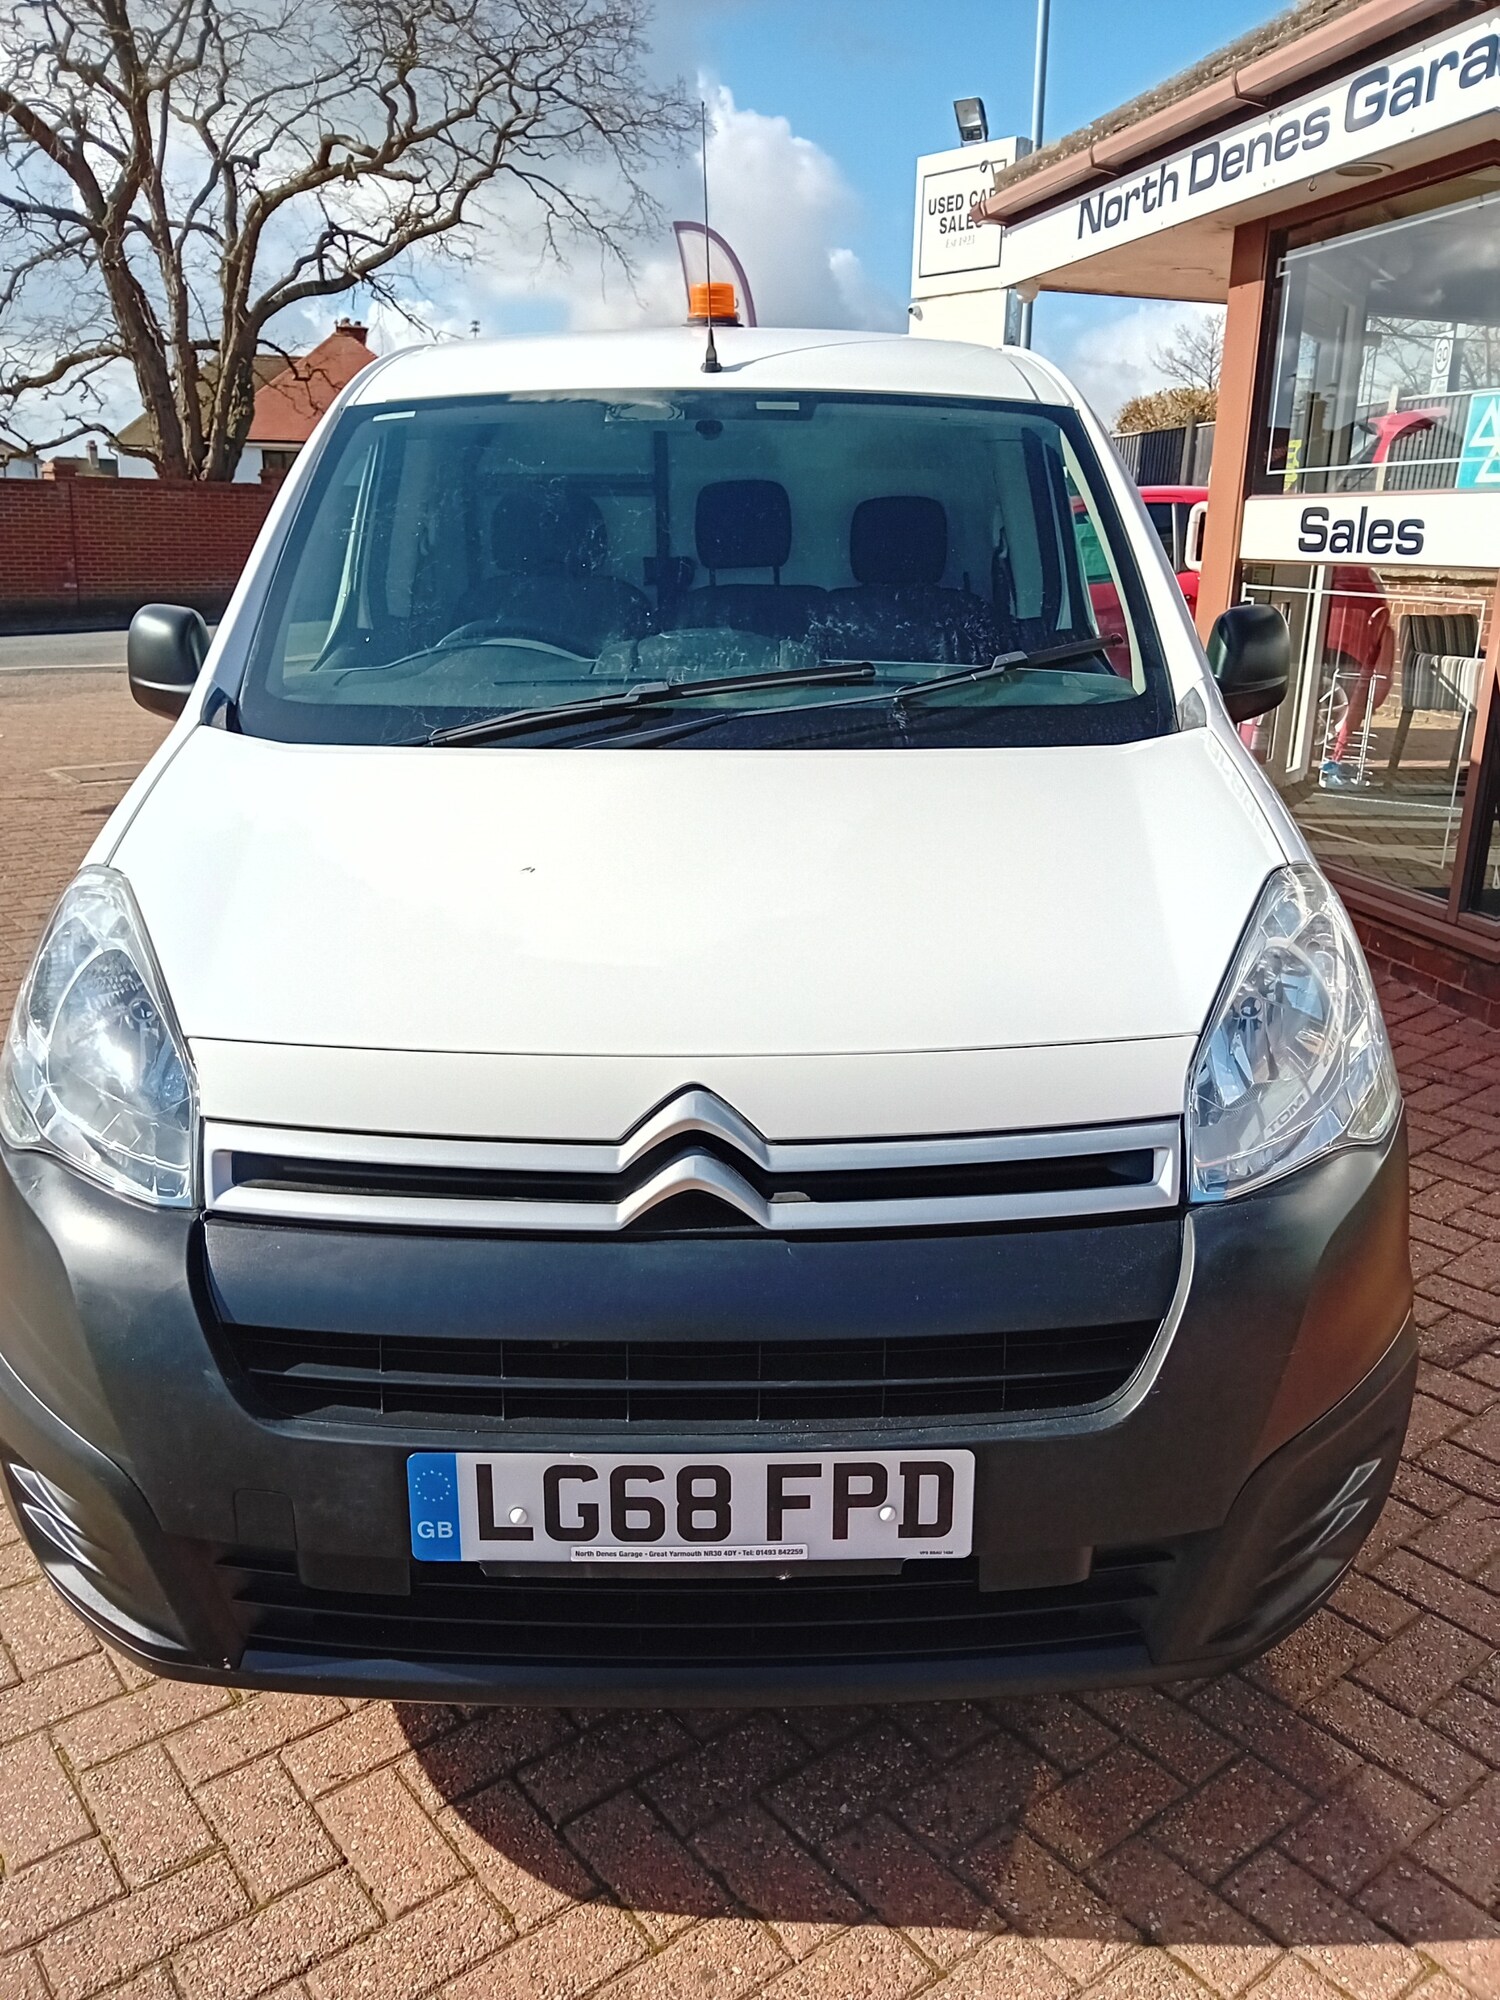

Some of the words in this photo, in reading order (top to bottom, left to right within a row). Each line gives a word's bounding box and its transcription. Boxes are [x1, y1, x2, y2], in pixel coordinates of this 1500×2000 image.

[1077, 163, 1179, 240] North
[1188, 106, 1331, 195] Denes
[1344, 33, 1500, 133] Gara
[928, 193, 964, 216] USED
[939, 213, 983, 235] SALE
[1298, 505, 1425, 555] Sales
[475, 1463, 732, 1543] LG68
[766, 1461, 955, 1542] FPD
[416, 1520, 454, 1540] GB
[575, 1549, 595, 1557] North
[618, 1550, 643, 1558] Garage
[777, 1548, 804, 1556] 842259
